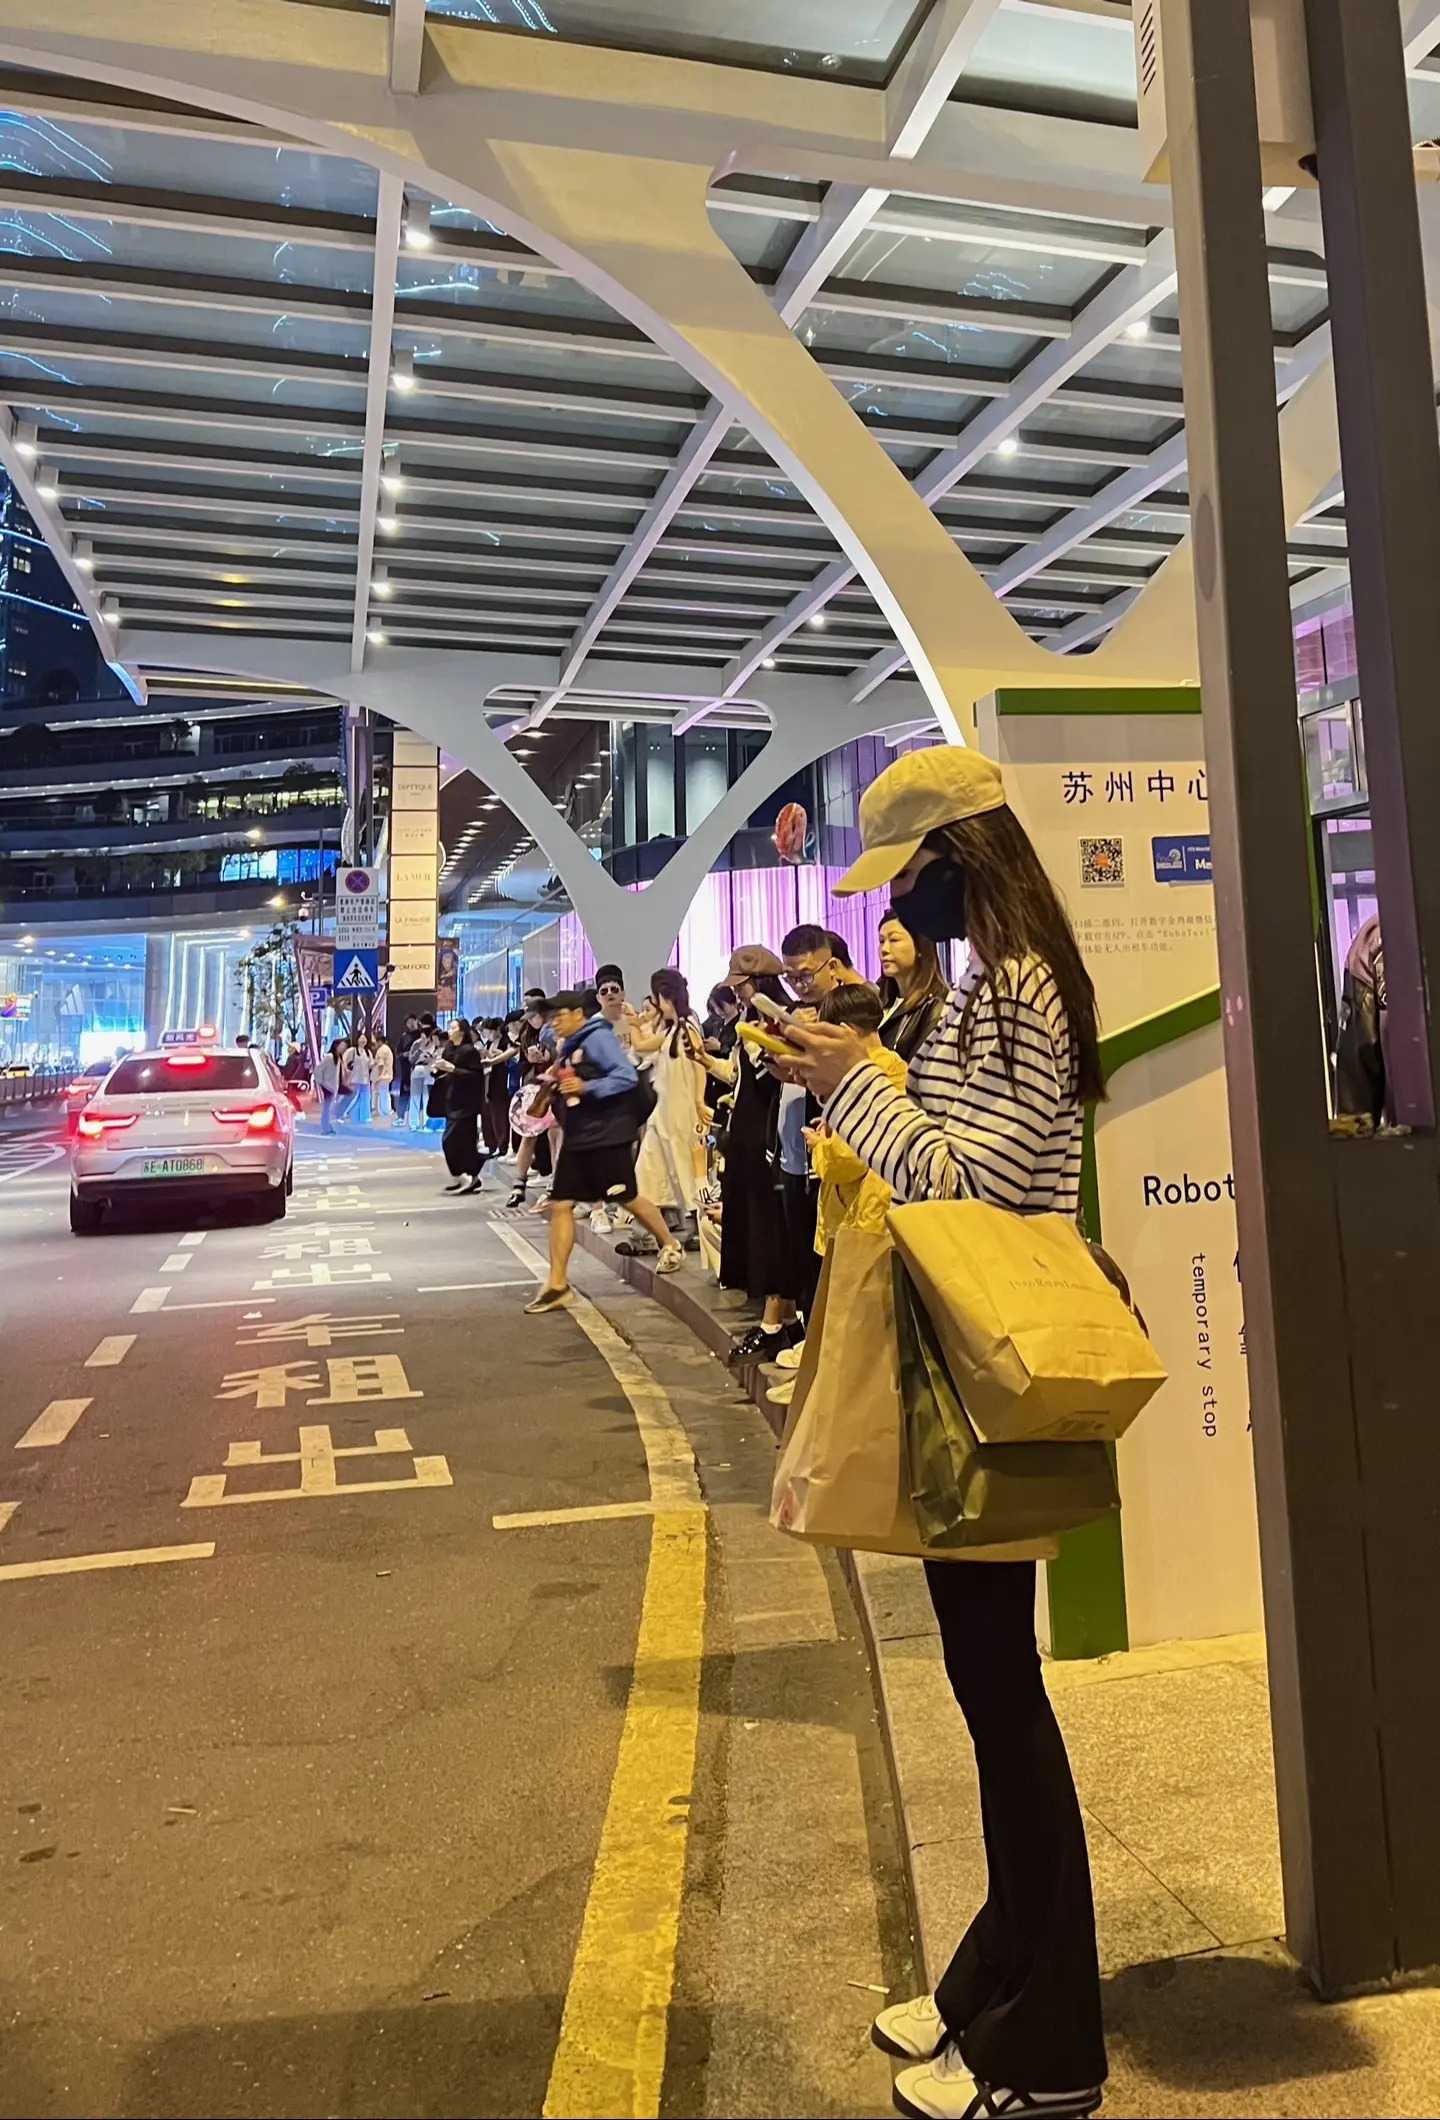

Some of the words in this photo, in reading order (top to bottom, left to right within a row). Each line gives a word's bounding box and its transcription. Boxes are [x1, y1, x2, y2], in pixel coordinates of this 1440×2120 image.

[1061, 768, 1210, 805] 苏州中心
[1191, 1252, 1212, 1370] temporary
[1202, 1385, 1218, 1438] stop
